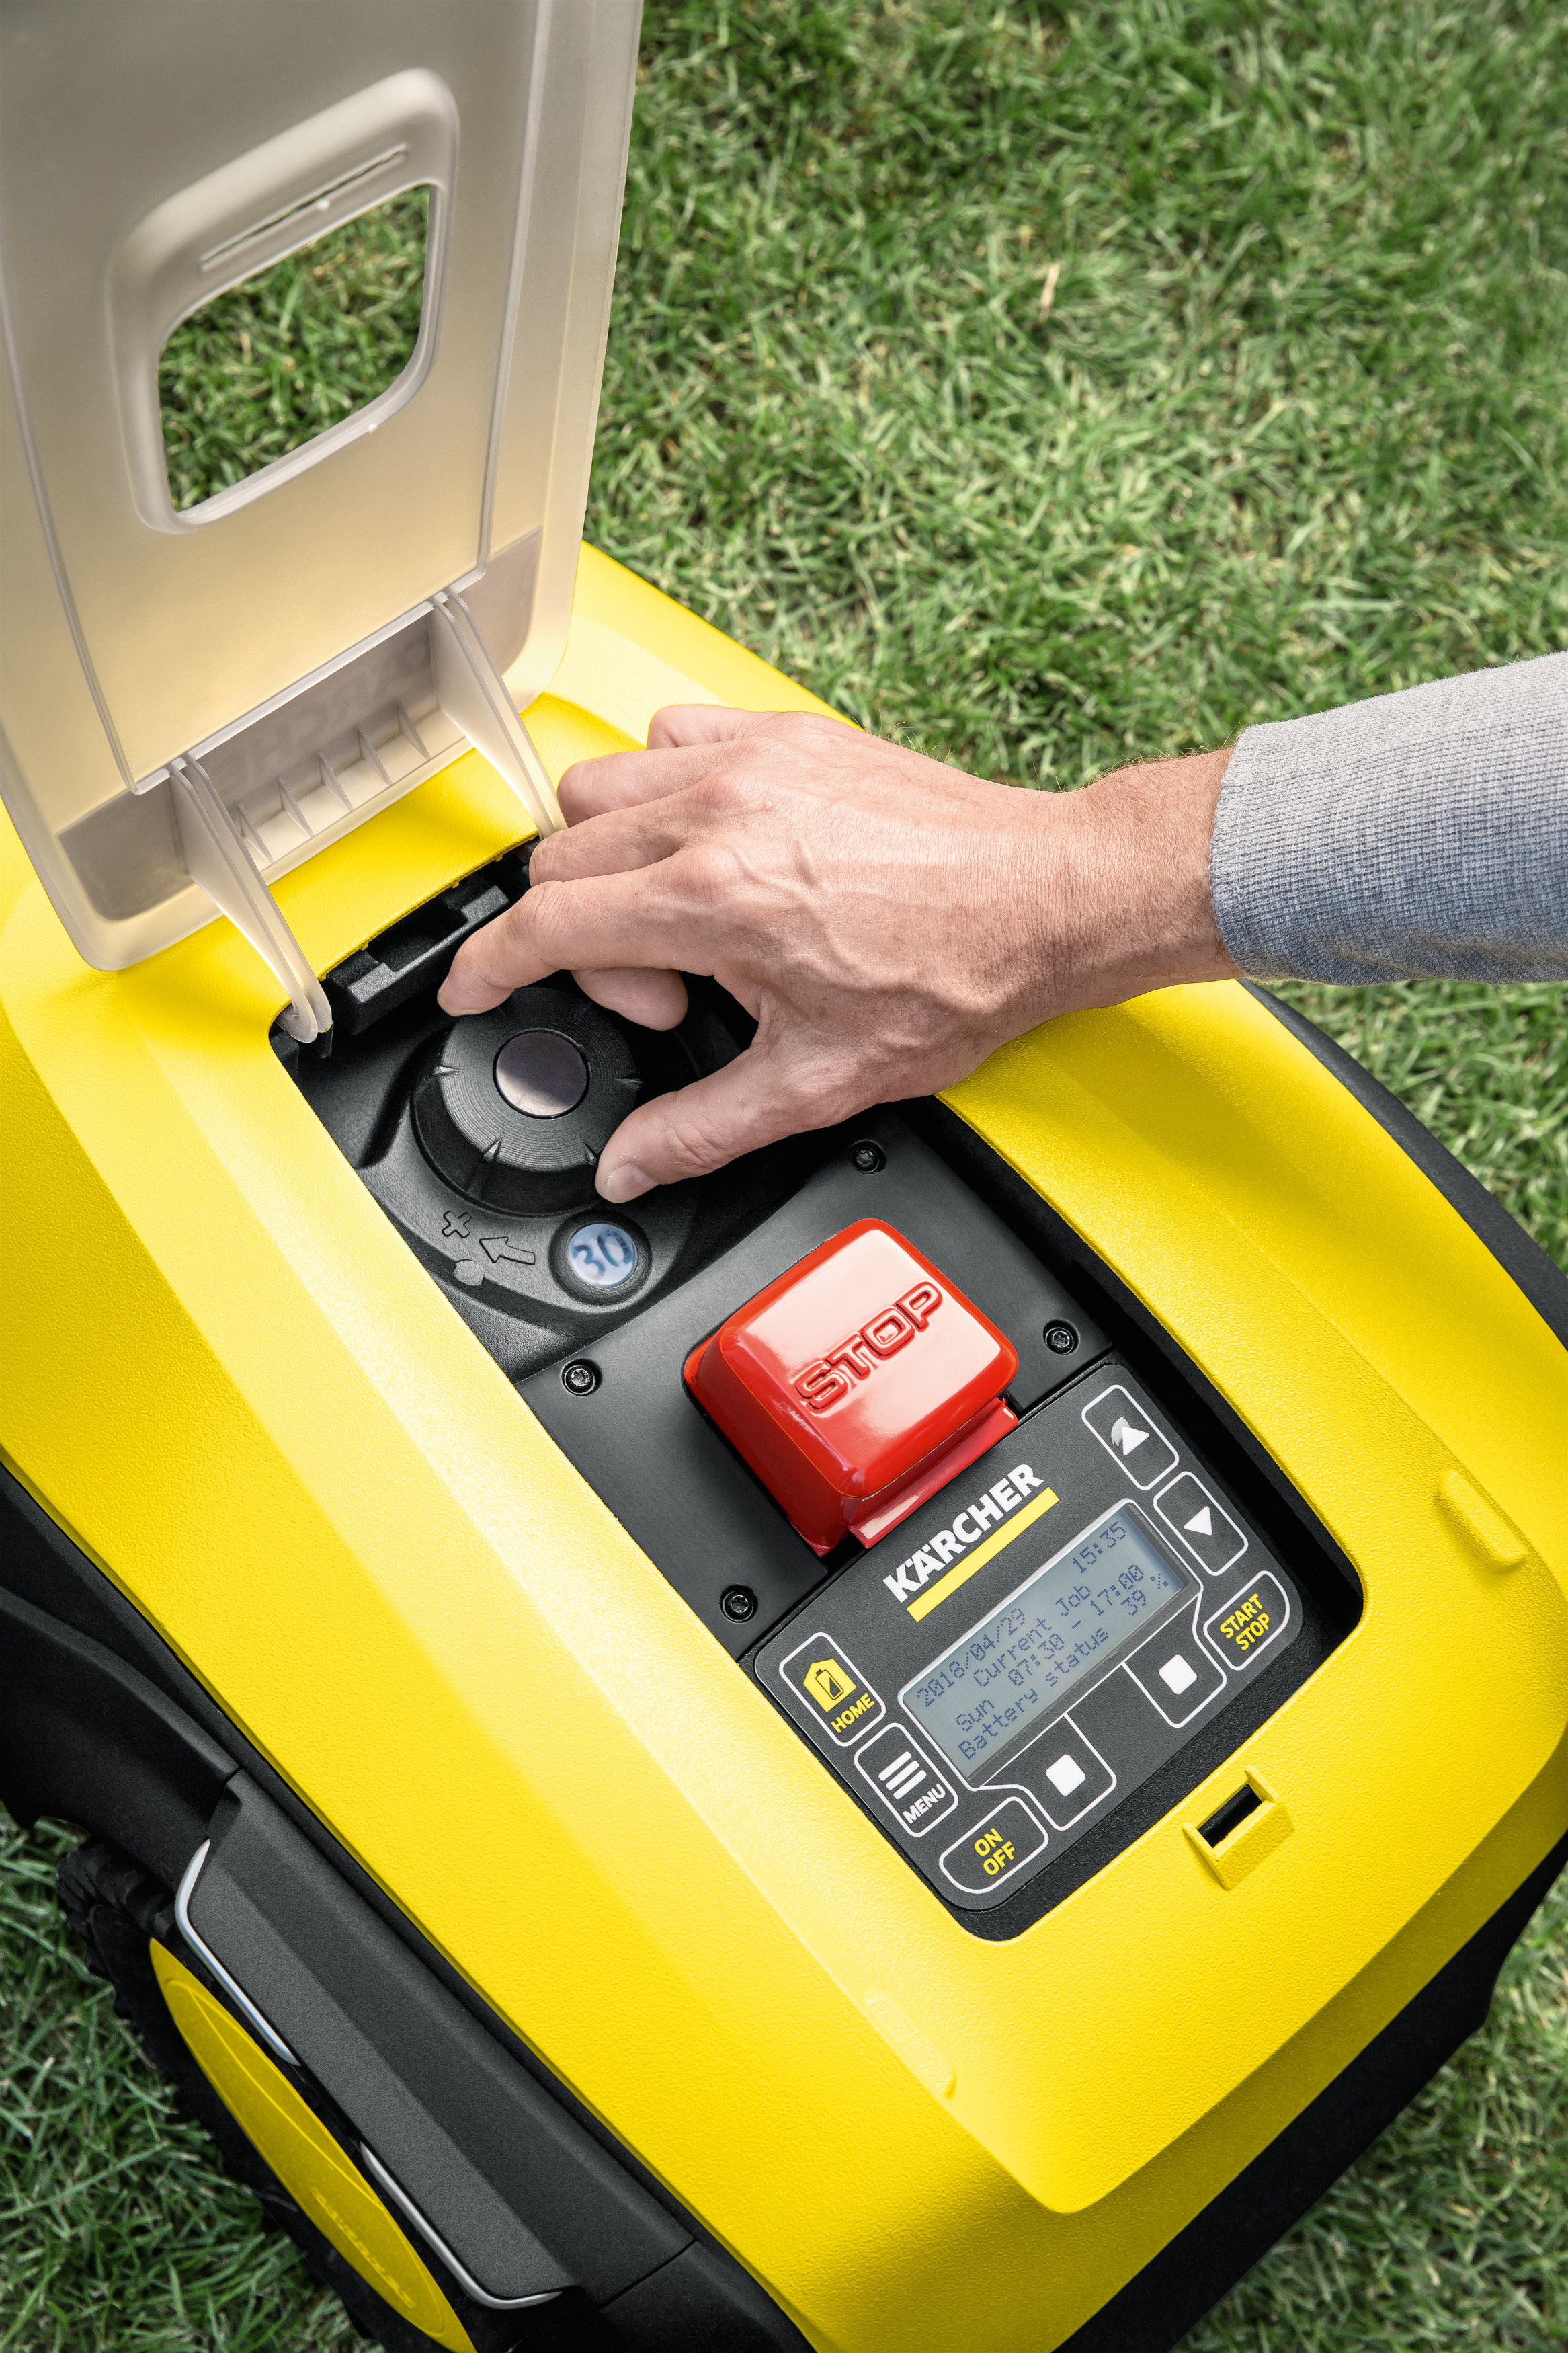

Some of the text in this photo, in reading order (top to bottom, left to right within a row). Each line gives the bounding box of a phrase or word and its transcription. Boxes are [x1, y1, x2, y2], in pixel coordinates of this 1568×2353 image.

[573, 1230, 631, 1280] 30
[794, 1281, 943, 1411] STOP
[882, 1463, 1043, 1603] KÄRCHER
[917, 1521, 1126, 1708] 2018/04/29 15:35
[973, 1585, 1091, 1687] Current Job
[1220, 1593, 1263, 1639] START
[1235, 1613, 1270, 1651] STOP
[955, 1699, 995, 1732] Sun
[1007, 1633, 1065, 1687] 07:30
[1089, 1564, 1144, 1616] 17:00
[958, 1688, 1038, 1760] Battery
[1045, 1628, 1109, 1687] status
[1120, 1589, 1147, 1616] 39
[831, 1693, 875, 1734] HOME
[903, 1783, 946, 1825] MENU
[974, 1828, 1003, 1856] ON
[983, 1841, 1016, 1875] OFF
